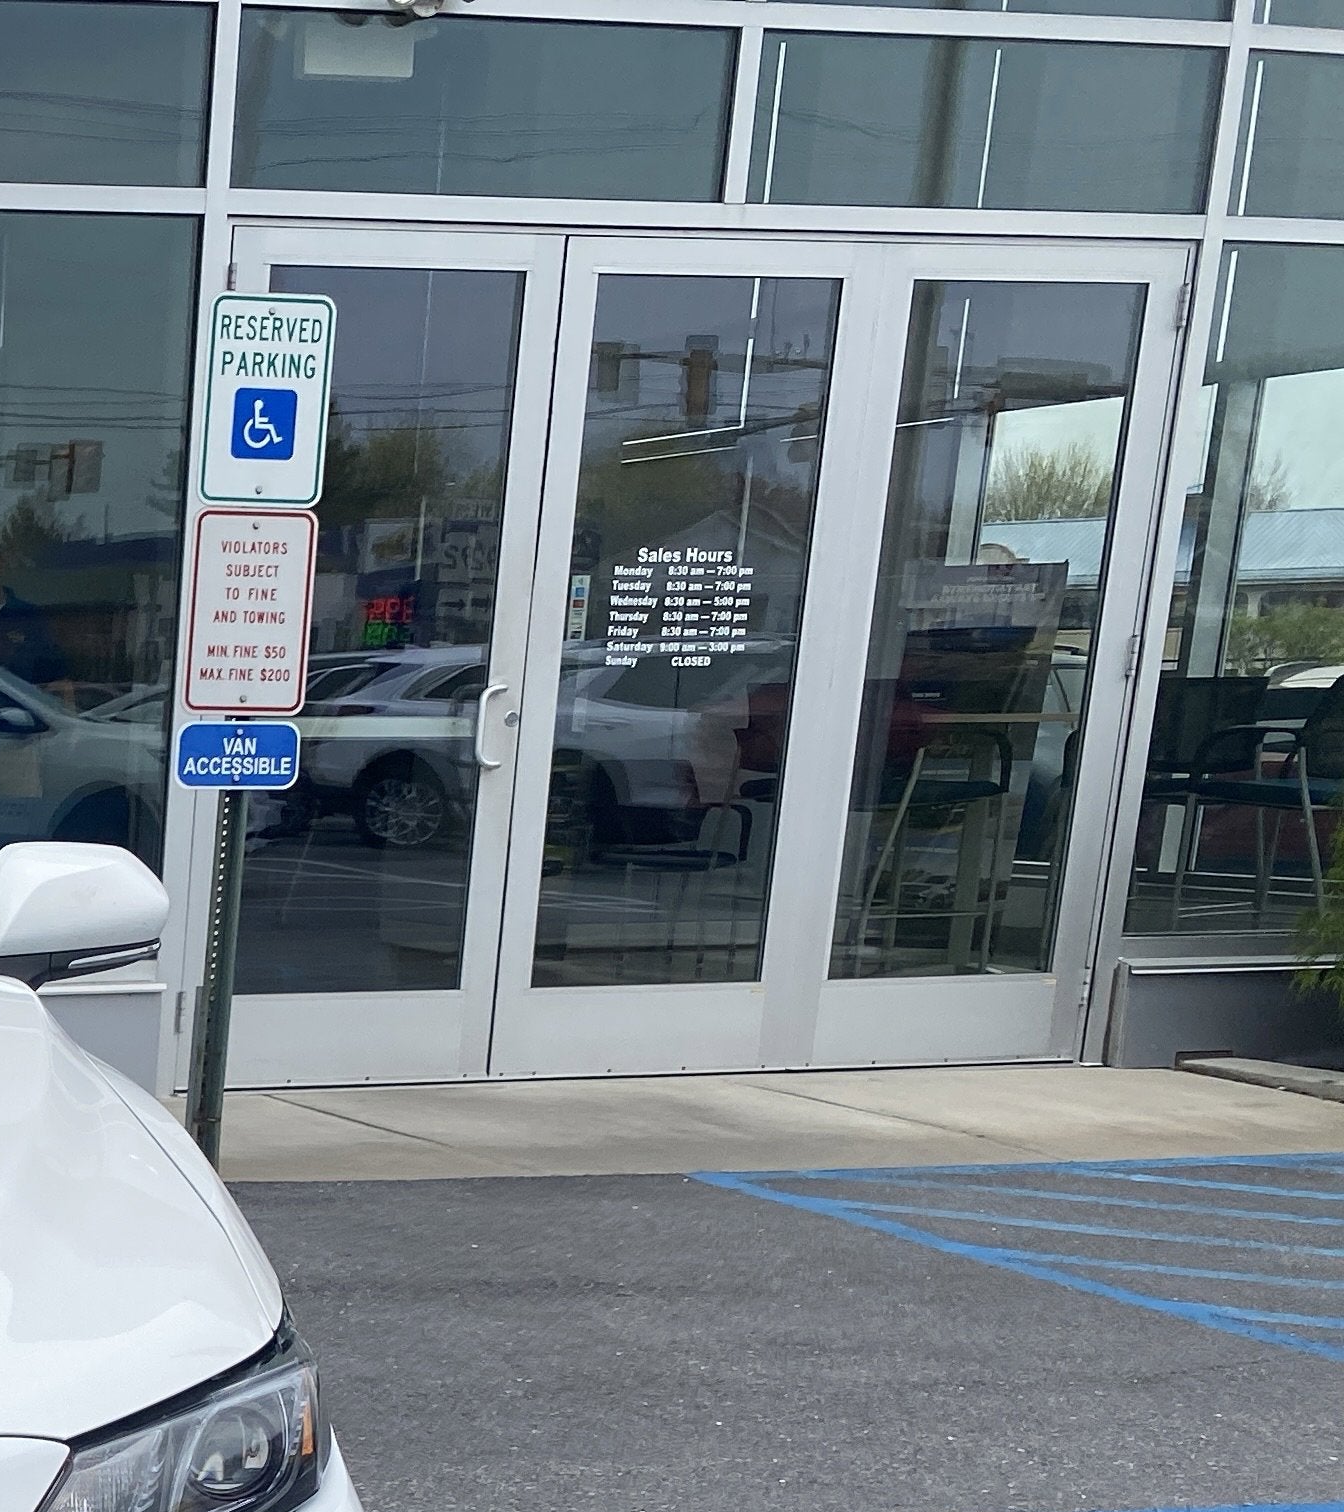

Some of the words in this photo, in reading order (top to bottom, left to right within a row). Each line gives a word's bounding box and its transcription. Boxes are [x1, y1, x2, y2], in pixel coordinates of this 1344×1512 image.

[220, 314, 323, 344] RESERVED
[221, 351, 317, 379] PARKING
[221, 540, 288, 556] VIOLATORS
[637, 548, 682, 563] Sales
[685, 548, 733, 563] Hours
[225, 563, 279, 579] SUBJECT
[614, 565, 653, 578] Monday
[690, 567, 704, 576] am
[739, 568, 753, 577] pm
[612, 580, 651, 592] Tuesday
[688, 583, 702, 591] am
[737, 583, 751, 593] pm
[225, 587, 240, 601] TO
[247, 587, 278, 602] FINE
[610, 595, 658, 608] Wednesday
[686, 598, 700, 606] am
[735, 598, 750, 608] pm
[212, 610, 239, 624] AND
[242, 610, 286, 625] TOWING
[609, 611, 649, 623] Thursday
[685, 613, 699, 621] am
[733, 613, 747, 623] pm
[607, 626, 639, 638] Friday
[683, 628, 697, 636] am
[731, 628, 746, 637] pm
[233, 645, 258, 659] FINE
[264, 645, 286, 659] $50
[606, 641, 653, 653] Saturday
[682, 644, 696, 652] am
[730, 644, 745, 653] pm
[605, 655, 637, 668] Sunday
[671, 656, 711, 667] CLOSED
[228, 667, 254, 681] FINE
[260, 667, 290, 682] $200
[223, 738, 258, 755] VAN
[183, 756, 292, 776] ACCESSIBLE
